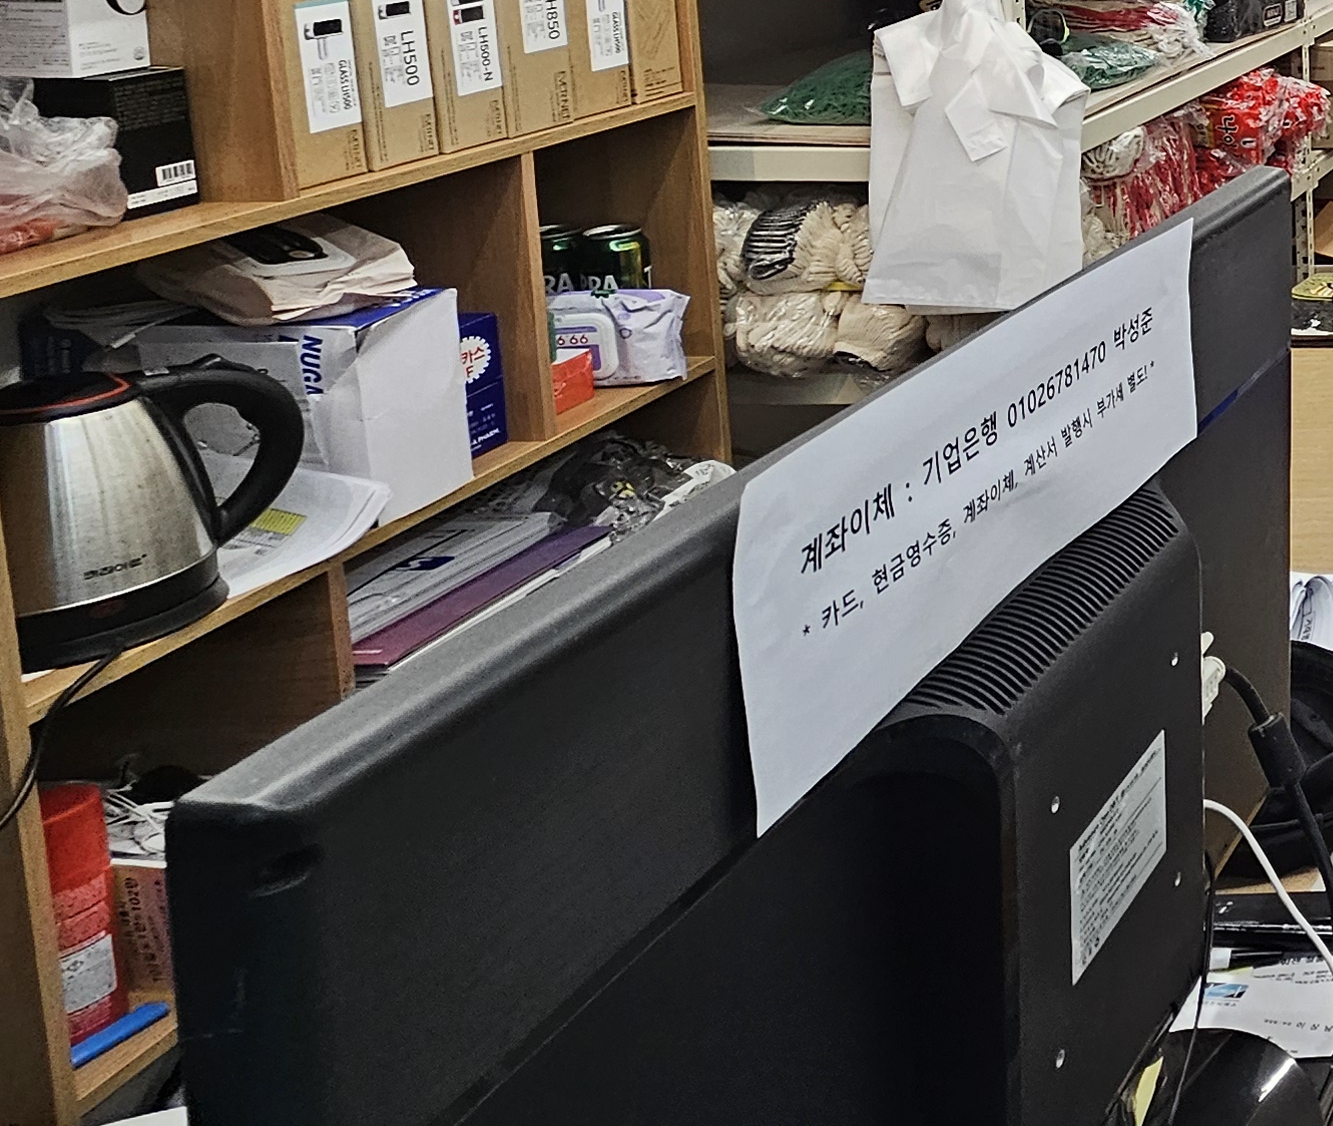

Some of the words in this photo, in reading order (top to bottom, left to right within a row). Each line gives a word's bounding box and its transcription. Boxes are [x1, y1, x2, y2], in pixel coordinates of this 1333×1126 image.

[338, 59, 349, 84] GLASS
[399, 29, 421, 87] LH500
[477, 25, 494, 83] LH500-N
[342, 83, 353, 111] LH500
[800, 484, 897, 576] 계좌이체
[922, 415, 999, 488] 기업은행
[1007, 341, 1107, 429] 01026781470
[1112, 306, 1154, 352] 박성준
[821, 593, 866, 634] 카드,
[871, 519, 958, 597] 현금영수증,
[962, 469, 1022, 527] 계좌이체,
[1024, 436, 1060, 479] 계산서
[1060, 410, 1095, 448] 발행시
[1096, 385, 1127, 418] 부가세
[1126, 366, 1150, 395] 별도!
